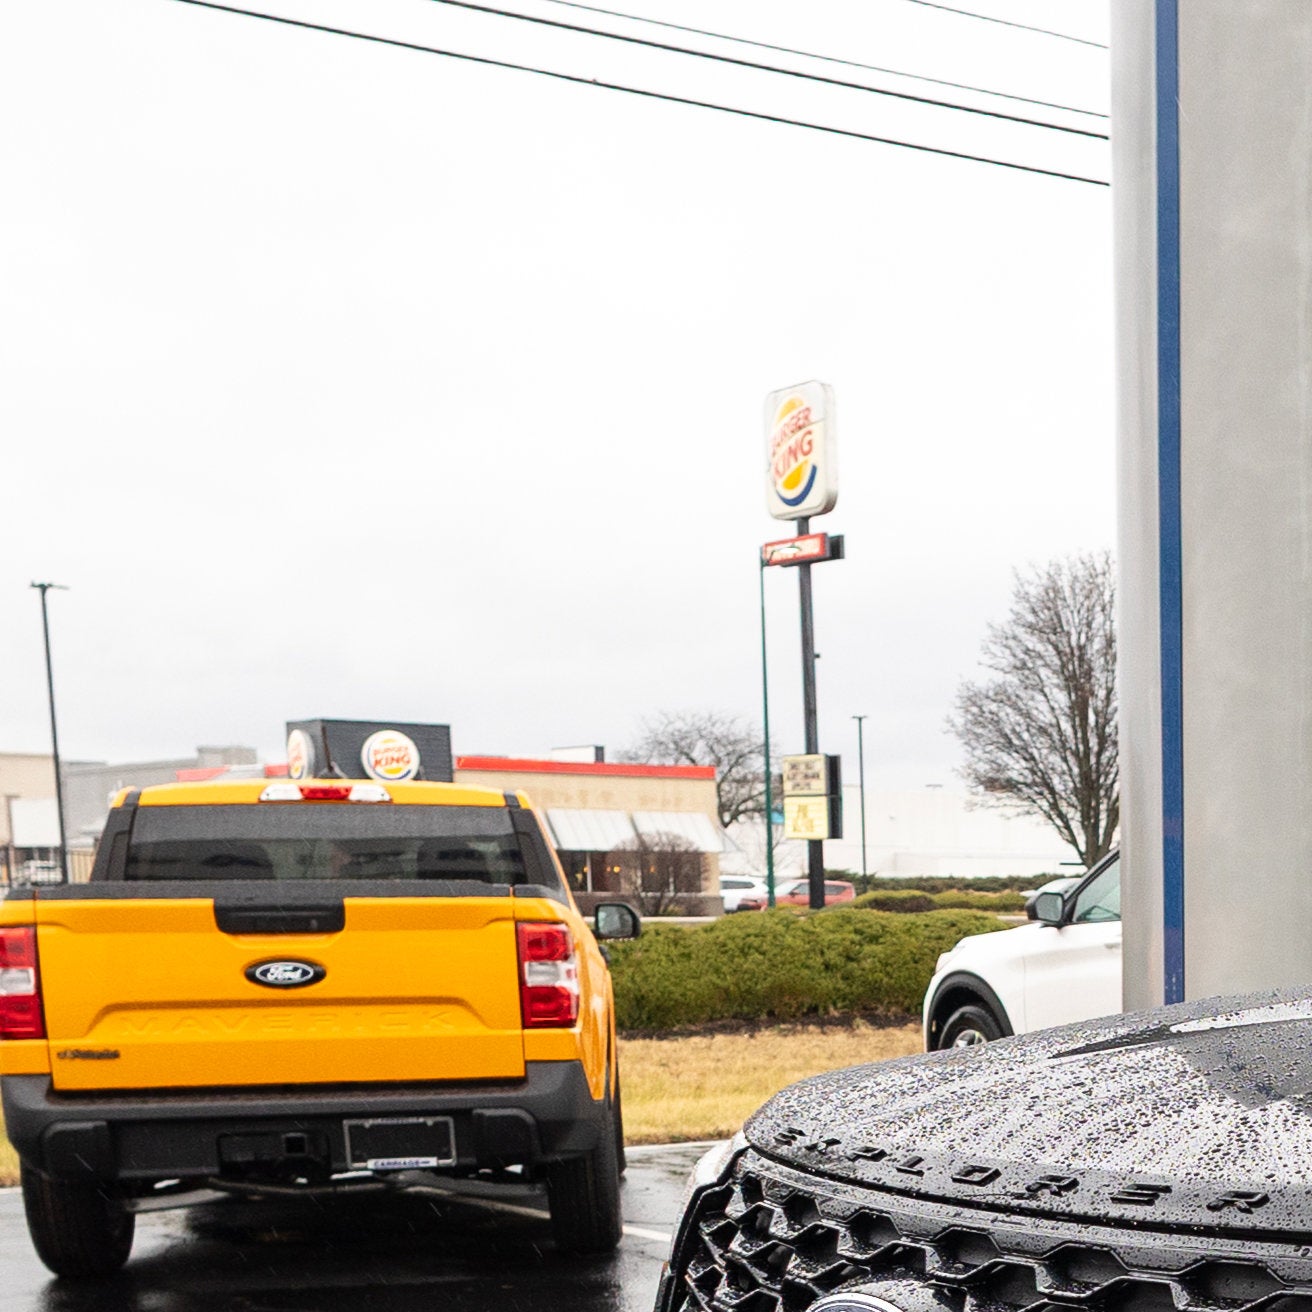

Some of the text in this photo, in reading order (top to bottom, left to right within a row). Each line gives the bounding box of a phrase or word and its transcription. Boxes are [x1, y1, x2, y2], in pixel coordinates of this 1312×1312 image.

[773, 430, 813, 479] KING
[374, 754, 411, 768] KING
[265, 964, 304, 981] Ford
[118, 1010, 457, 1037] MAVERICK
[772, 1126, 1272, 1215] EXPLORER
